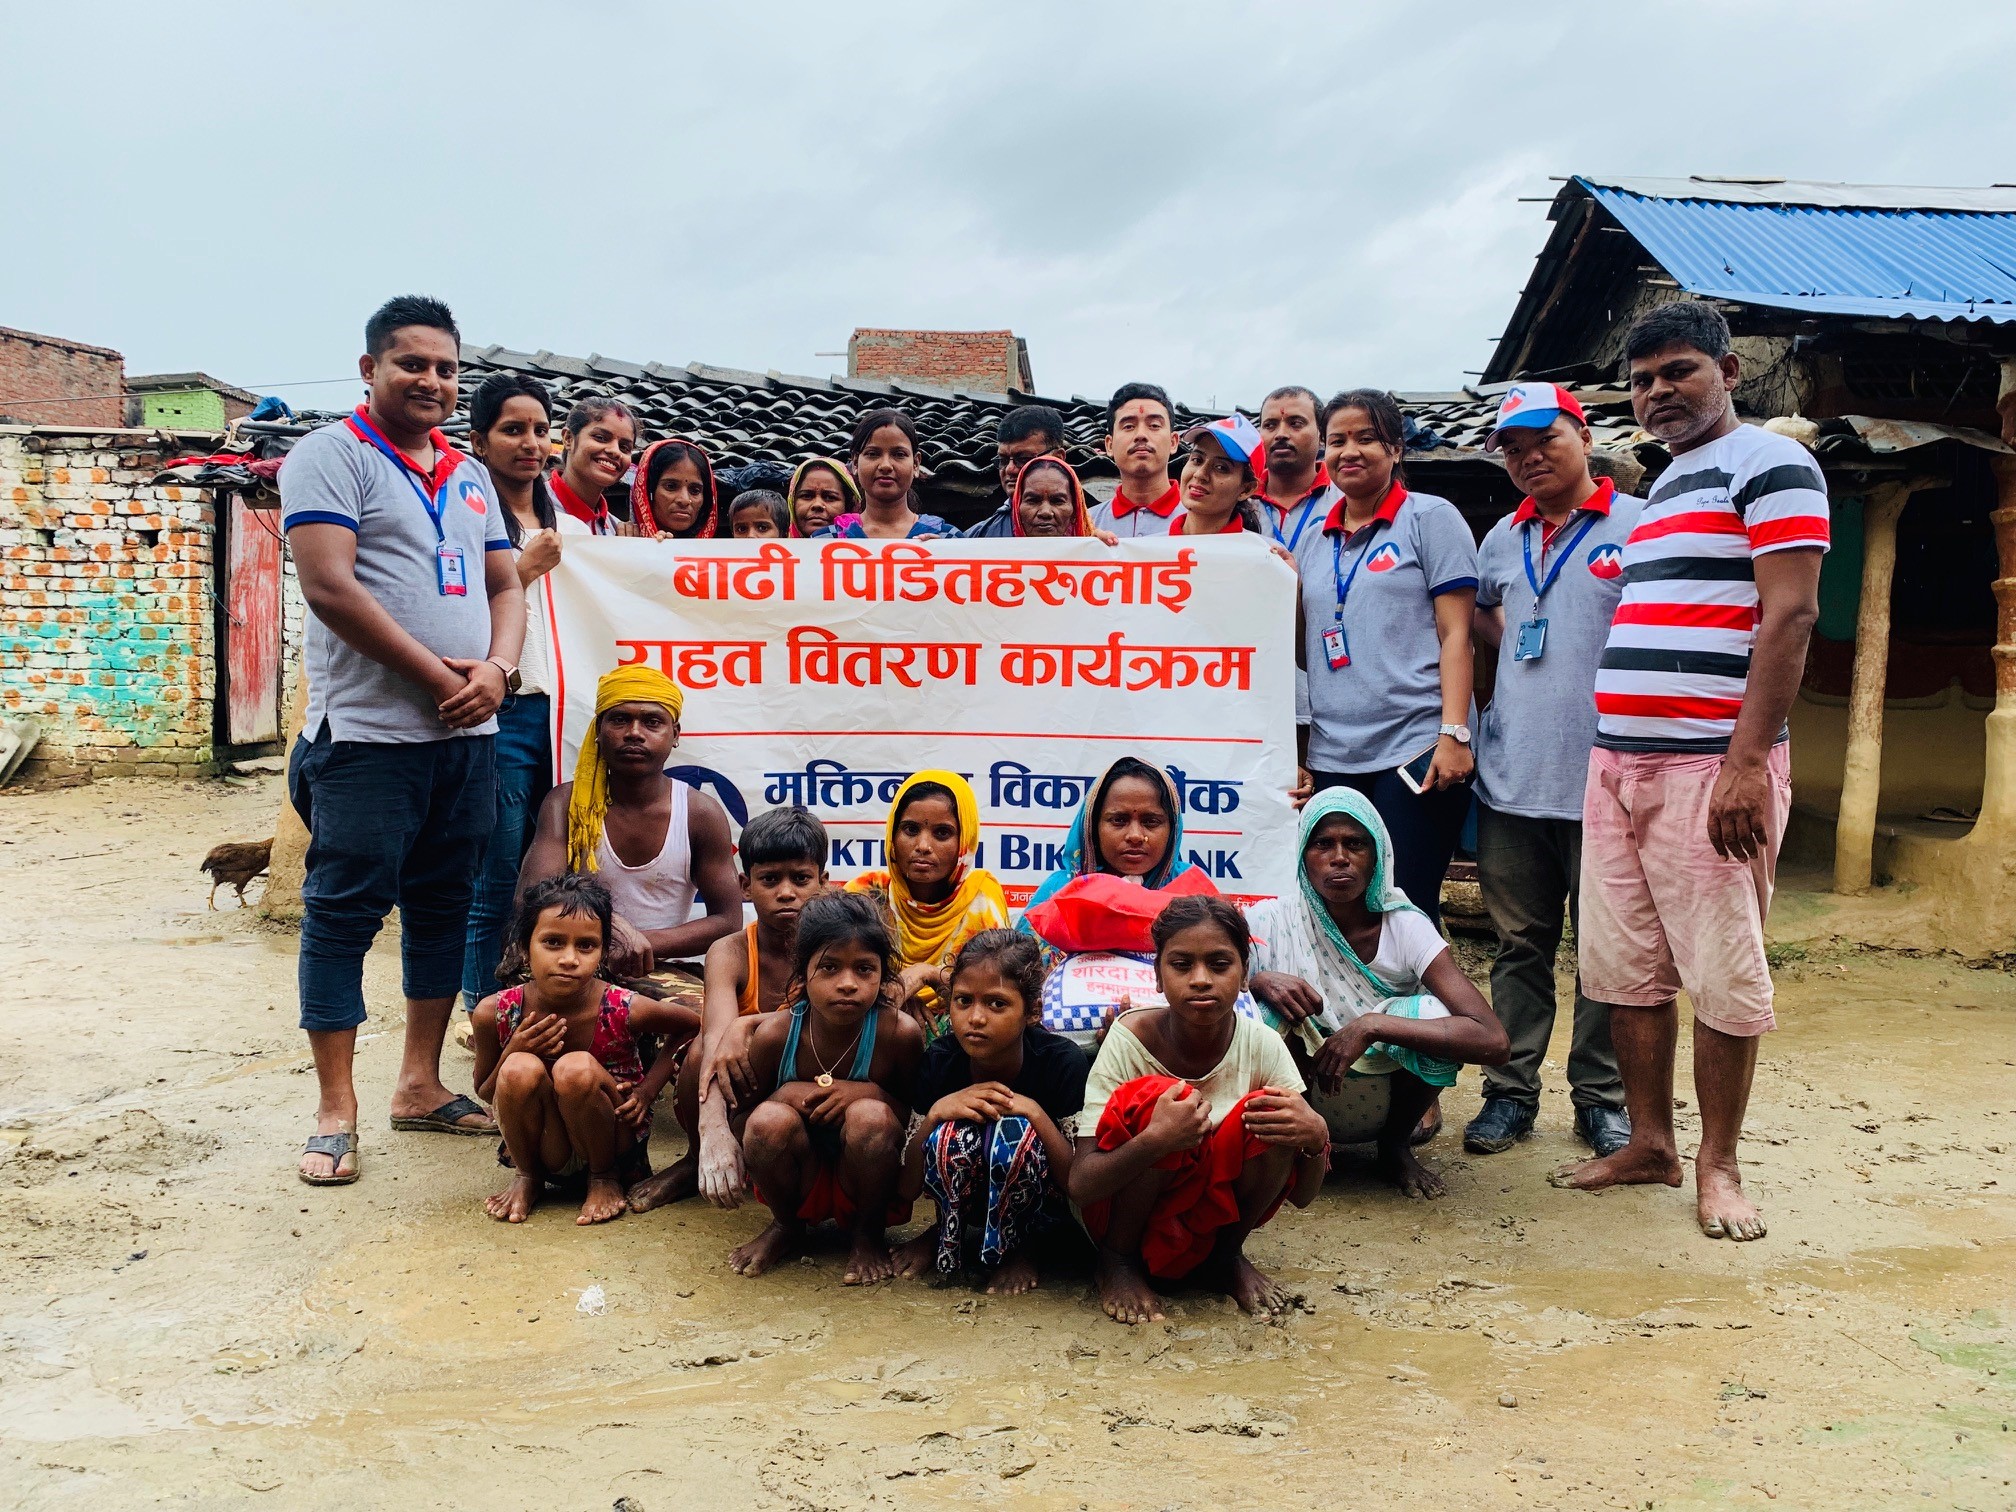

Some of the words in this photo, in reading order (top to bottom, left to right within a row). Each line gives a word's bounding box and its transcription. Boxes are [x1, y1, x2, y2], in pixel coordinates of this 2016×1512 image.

[673, 543, 800, 601] बाढी
[820, 542, 1198, 613] पिडितहरूलाई
[786, 626, 982, 687] वितरण
[1000, 631, 1256, 691] कार्यक्रम
[989, 761, 1098, 809] विका
[1000, 834, 1067, 870] BIK
